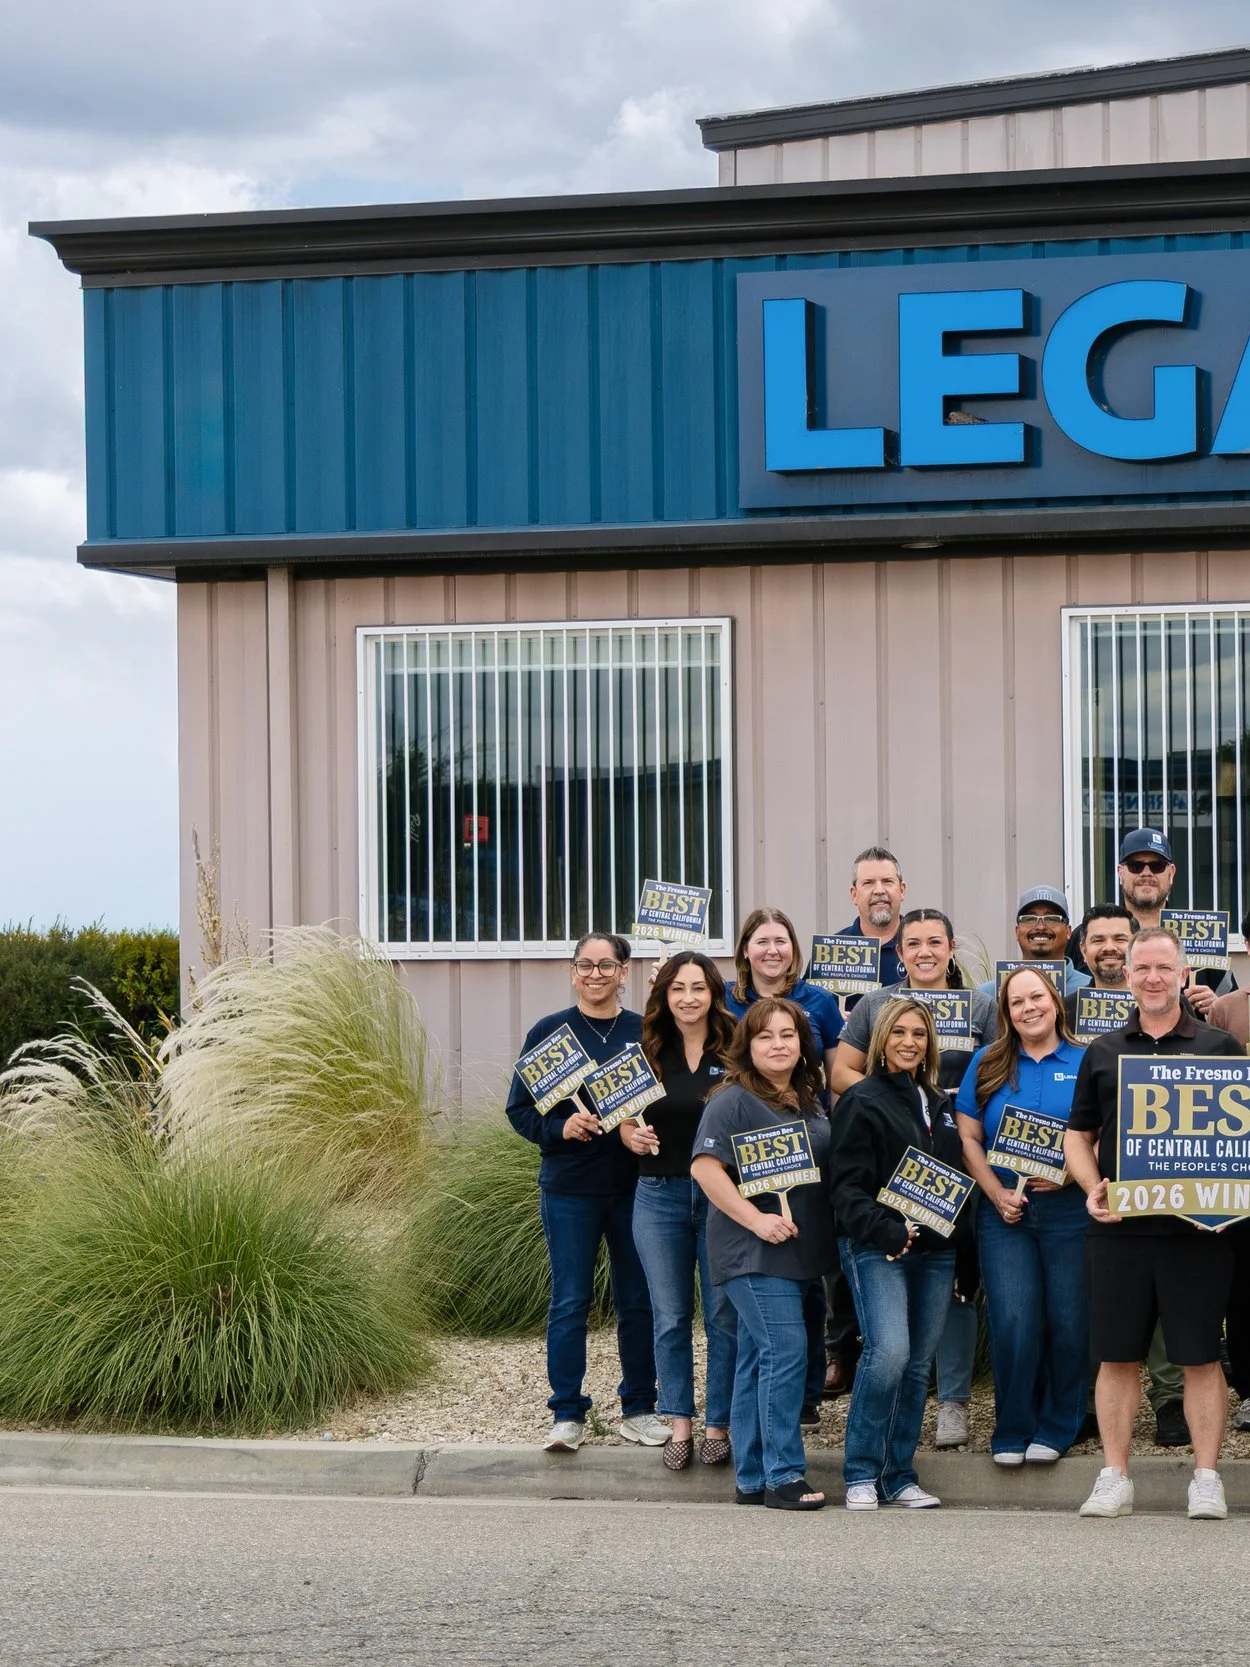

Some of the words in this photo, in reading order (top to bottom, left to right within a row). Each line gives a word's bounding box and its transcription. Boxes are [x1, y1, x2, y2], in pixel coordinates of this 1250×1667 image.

[643, 890, 706, 916] BEST
[649, 910, 671, 920] CENTRAL
[635, 926, 659, 937] 2026
[663, 928, 703, 945] WINNER
[1195, 940, 1225, 948] CALIFORNIA
[814, 944, 877, 966] BEST
[1187, 956, 1228, 969] WINNER
[822, 964, 844, 972] CENTRAL
[846, 966, 875, 974] CALIFORNIA
[1088, 1019, 1111, 1027] CENTRAL
[521, 1034, 576, 1087] BEST
[524, 1056, 535, 1065] The
[538, 1071, 558, 1088] CENTRAL
[590, 1054, 645, 1103] BEST
[593, 1071, 604, 1080] The
[1150, 1065, 1181, 1079] The
[1185, 1066, 1242, 1080] Fresno
[539, 1090, 561, 1113] 2026
[560, 1060, 597, 1093] WINNER
[605, 1089, 626, 1105] CENTRAL
[604, 1108, 626, 1130] 2026
[626, 1083, 664, 1113] WINNER
[1016, 1111, 1028, 1120] The
[1028, 1115, 1050, 1126] Fresno
[1051, 1121, 1063, 1130] Bee
[757, 1131, 781, 1140] Fresno
[1001, 1116, 1066, 1152] BEST
[737, 1132, 804, 1166] BEST
[999, 1136, 1006, 1144] OF
[1007, 1138, 1030, 1151] CENTRAL
[1032, 1146, 1064, 1161] CALIFORNIA
[1127, 1139, 1142, 1156] OF
[1149, 1139, 1209, 1157] CENTRAL
[742, 1166, 749, 1174] OF
[750, 1160, 775, 1172] CENTRAL
[776, 1153, 809, 1166] CALIFORNIA
[917, 1155, 929, 1165] The
[928, 1161, 950, 1176] Fresno
[950, 1173, 962, 1183] Bee
[990, 1153, 1017, 1168] 2026
[1021, 1160, 1064, 1183] WINNER
[1148, 1162, 1169, 1170] THE
[743, 1179, 770, 1196] 2026
[772, 1167, 817, 1187] WINNER
[898, 1157, 967, 1204] BEST
[894, 1176, 903, 1184] OF
[902, 1180, 925, 1197] CENTRAL
[926, 1193, 956, 1214] CALIFORNIA
[1117, 1184, 1184, 1211] 2026
[881, 1192, 909, 1210] 2026
[911, 1204, 953, 1235] WINNER
